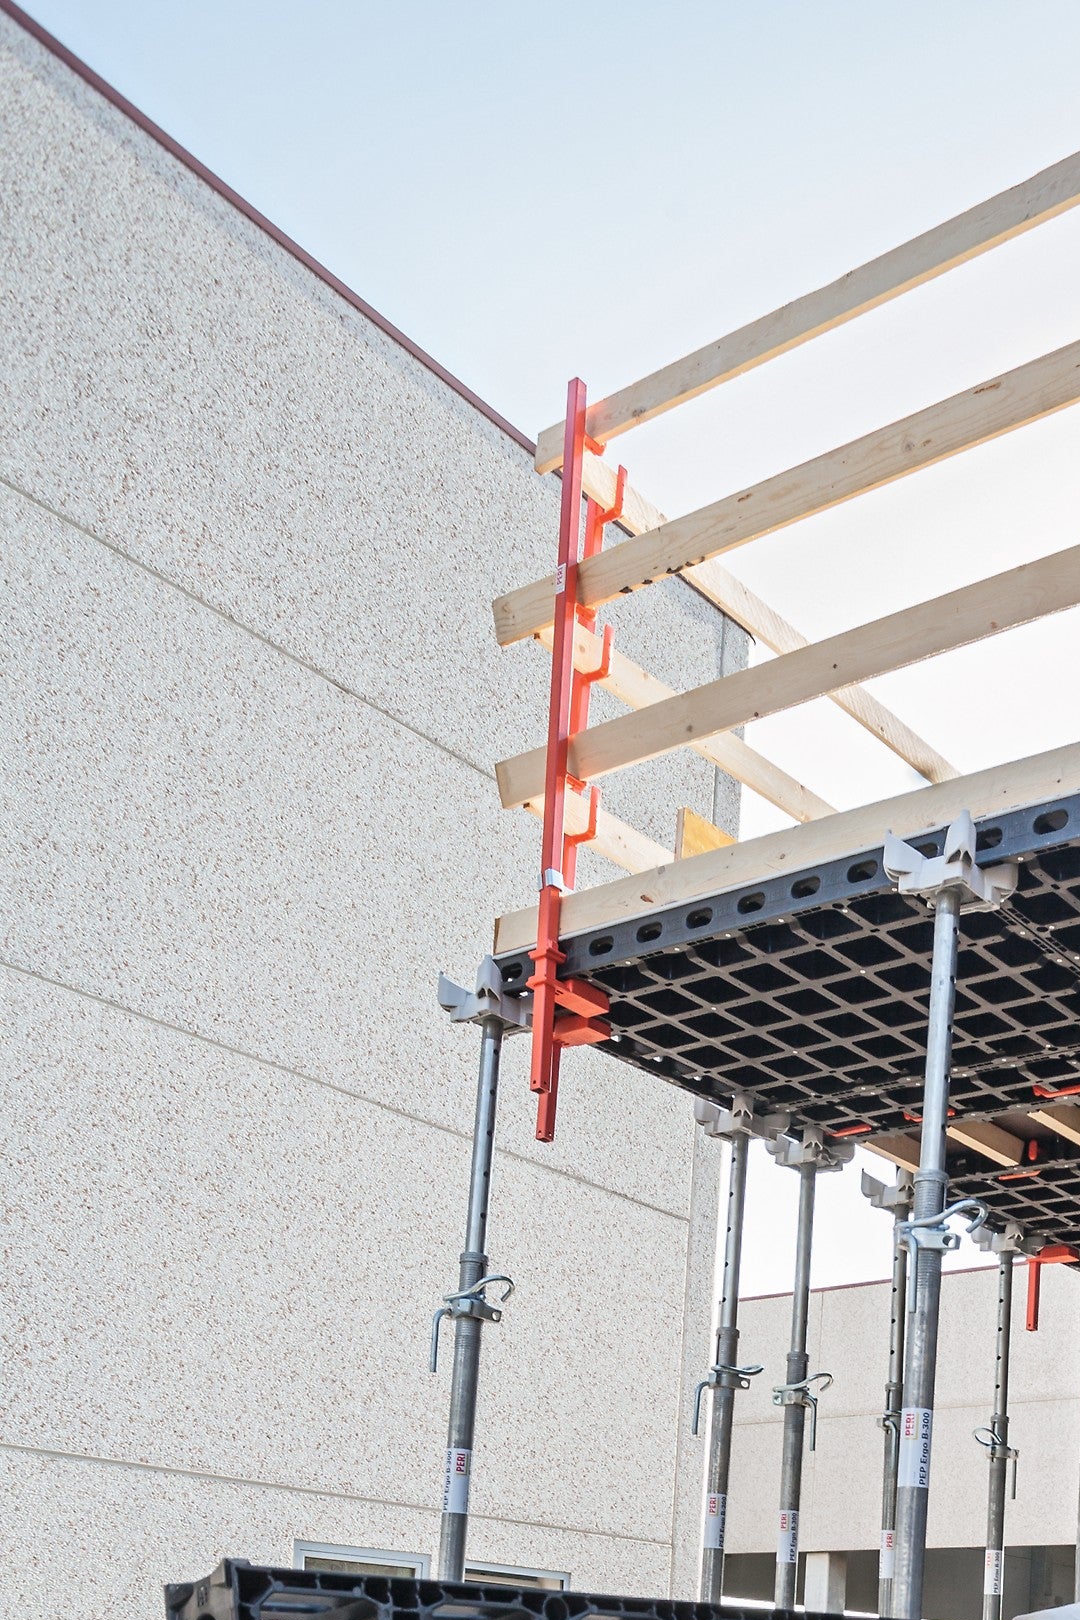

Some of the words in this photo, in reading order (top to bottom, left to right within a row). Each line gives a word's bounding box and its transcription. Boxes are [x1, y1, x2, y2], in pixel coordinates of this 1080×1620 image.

[905, 1413, 915, 1436] PERI
[922, 1412, 930, 1440] B-300
[456, 1453, 466, 1473] PERI
[920, 1442, 929, 1464] Ergo
[709, 1497, 717, 1513] PERI
